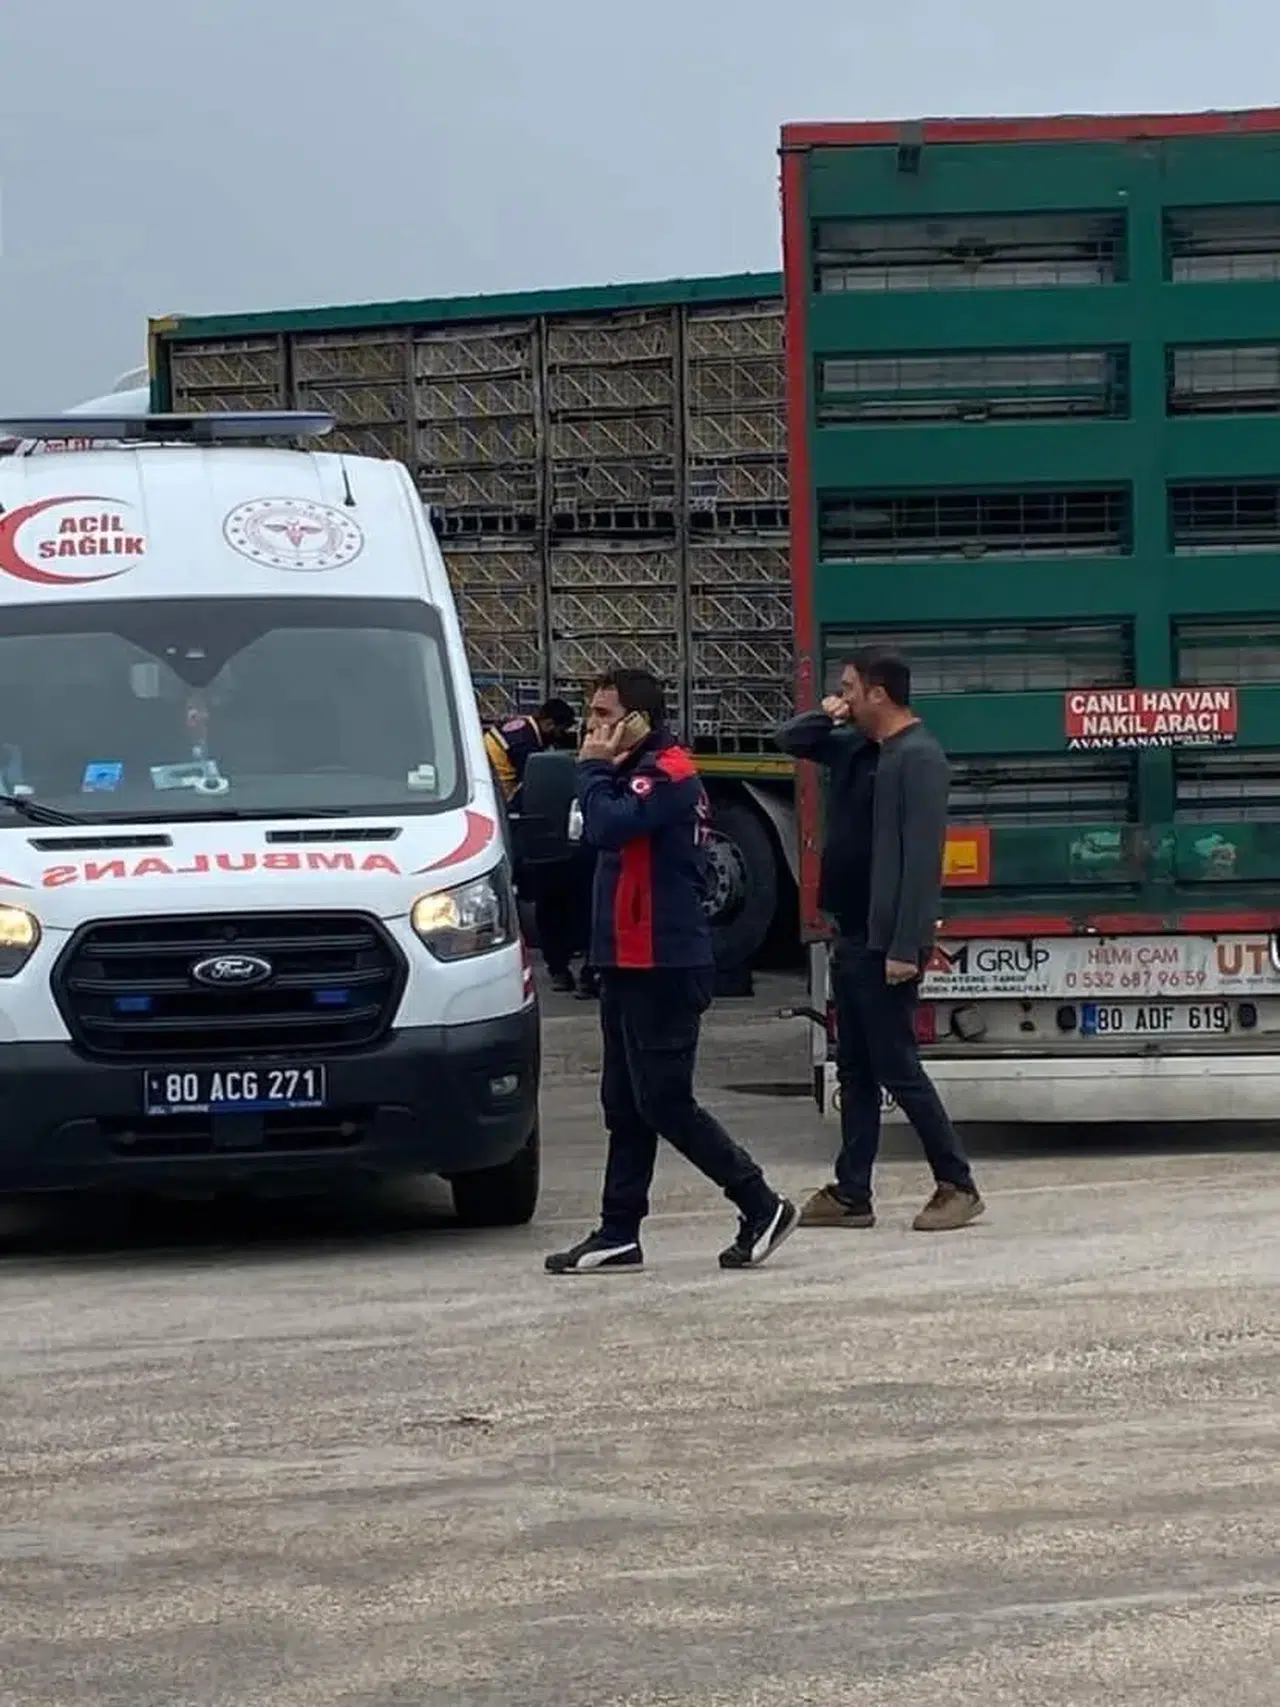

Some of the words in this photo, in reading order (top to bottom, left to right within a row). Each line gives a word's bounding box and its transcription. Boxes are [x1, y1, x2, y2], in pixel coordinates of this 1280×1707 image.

[38, 535, 144, 559] SAĞLIK
[1071, 694, 1136, 713] CANLI
[1143, 692, 1229, 711] HAYVAN
[1083, 714, 1149, 735] NAKİL
[1154, 713, 1219, 733] ARACI
[210, 960, 254, 979] Ford
[976, 949, 1050, 972] GRUP
[1065, 972, 1077, 988] 0
[1082, 972, 1114, 988] 532
[1120, 972, 1152, 988] 687
[1157, 972, 1179, 988] 96
[1097, 1007, 1123, 1031] 80
[1135, 1006, 1174, 1030] ADF
[1188, 1005, 1225, 1029] 619
[166, 1073, 198, 1102] 80
[210, 1072, 258, 1101] ACG
[268, 1069, 314, 1099] 271
